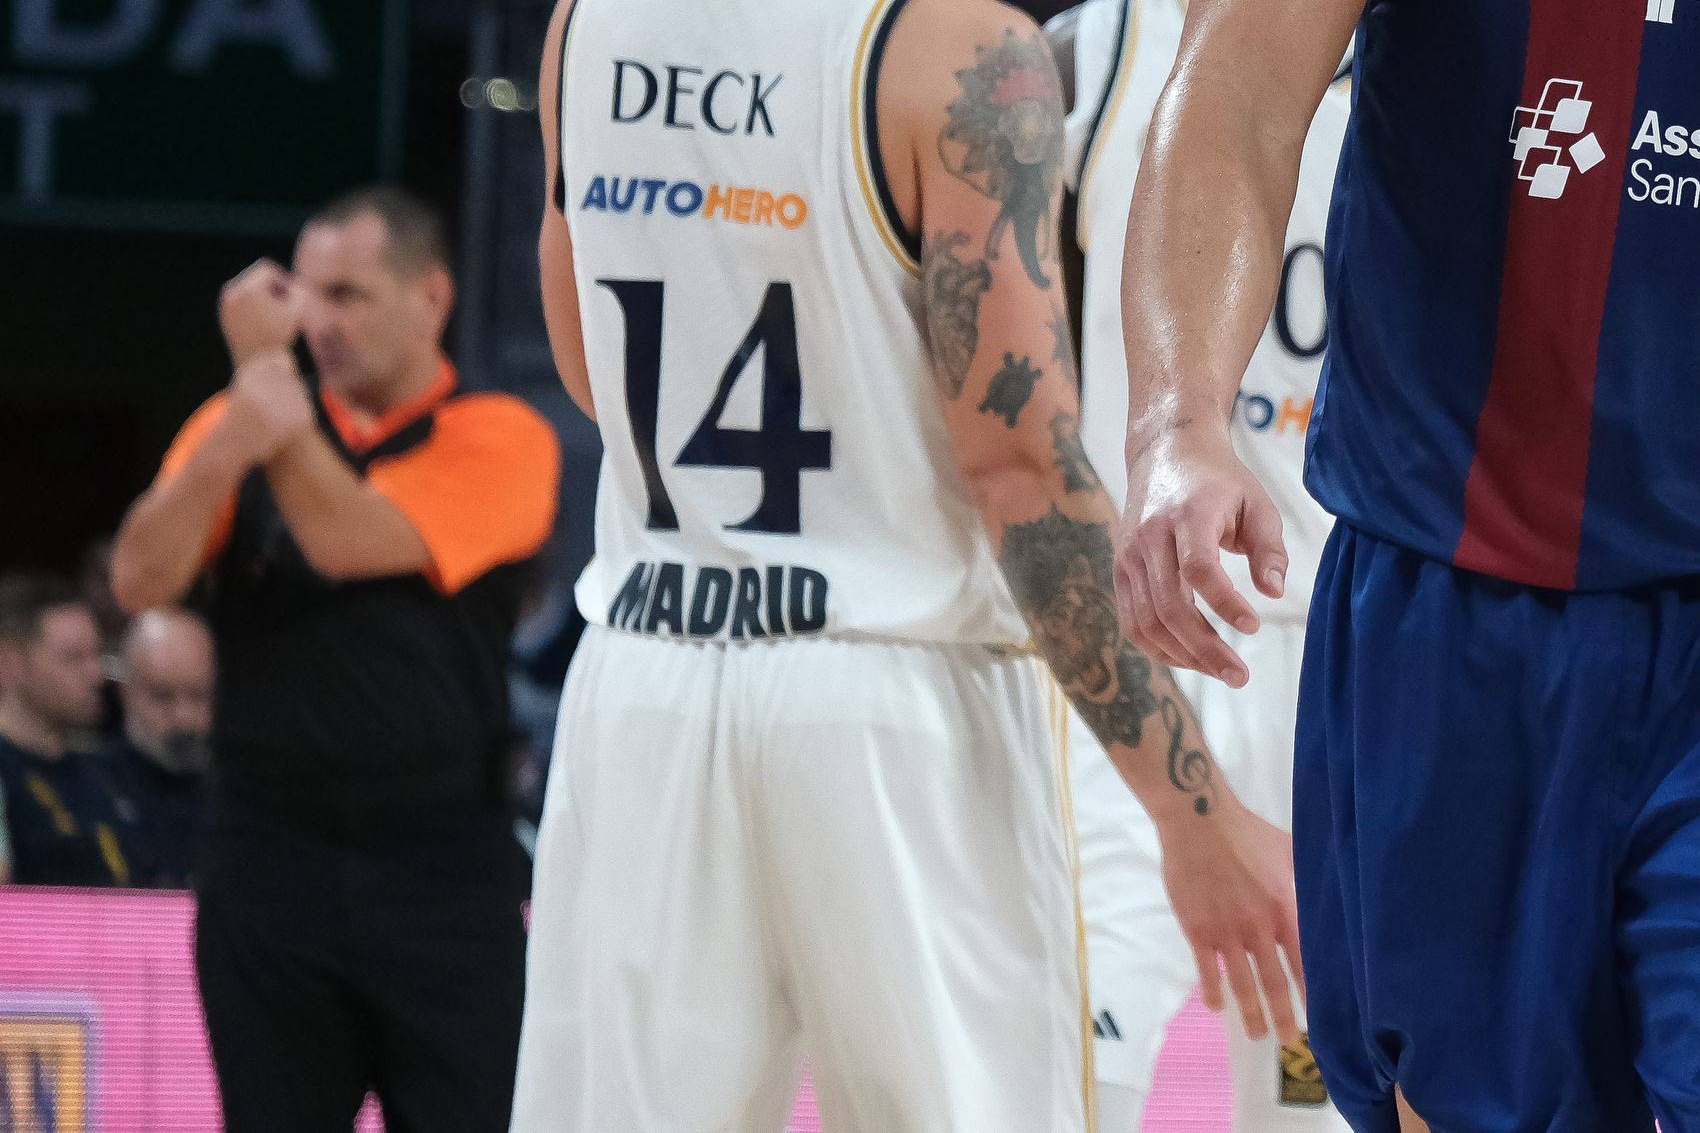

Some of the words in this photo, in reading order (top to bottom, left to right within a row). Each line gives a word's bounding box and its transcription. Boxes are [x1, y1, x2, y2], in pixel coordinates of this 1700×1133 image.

[612, 59, 783, 139] DECK
[582, 175, 809, 231] AUTOHERO
[595, 279, 832, 534] 14
[609, 561, 828, 639] MADRID
